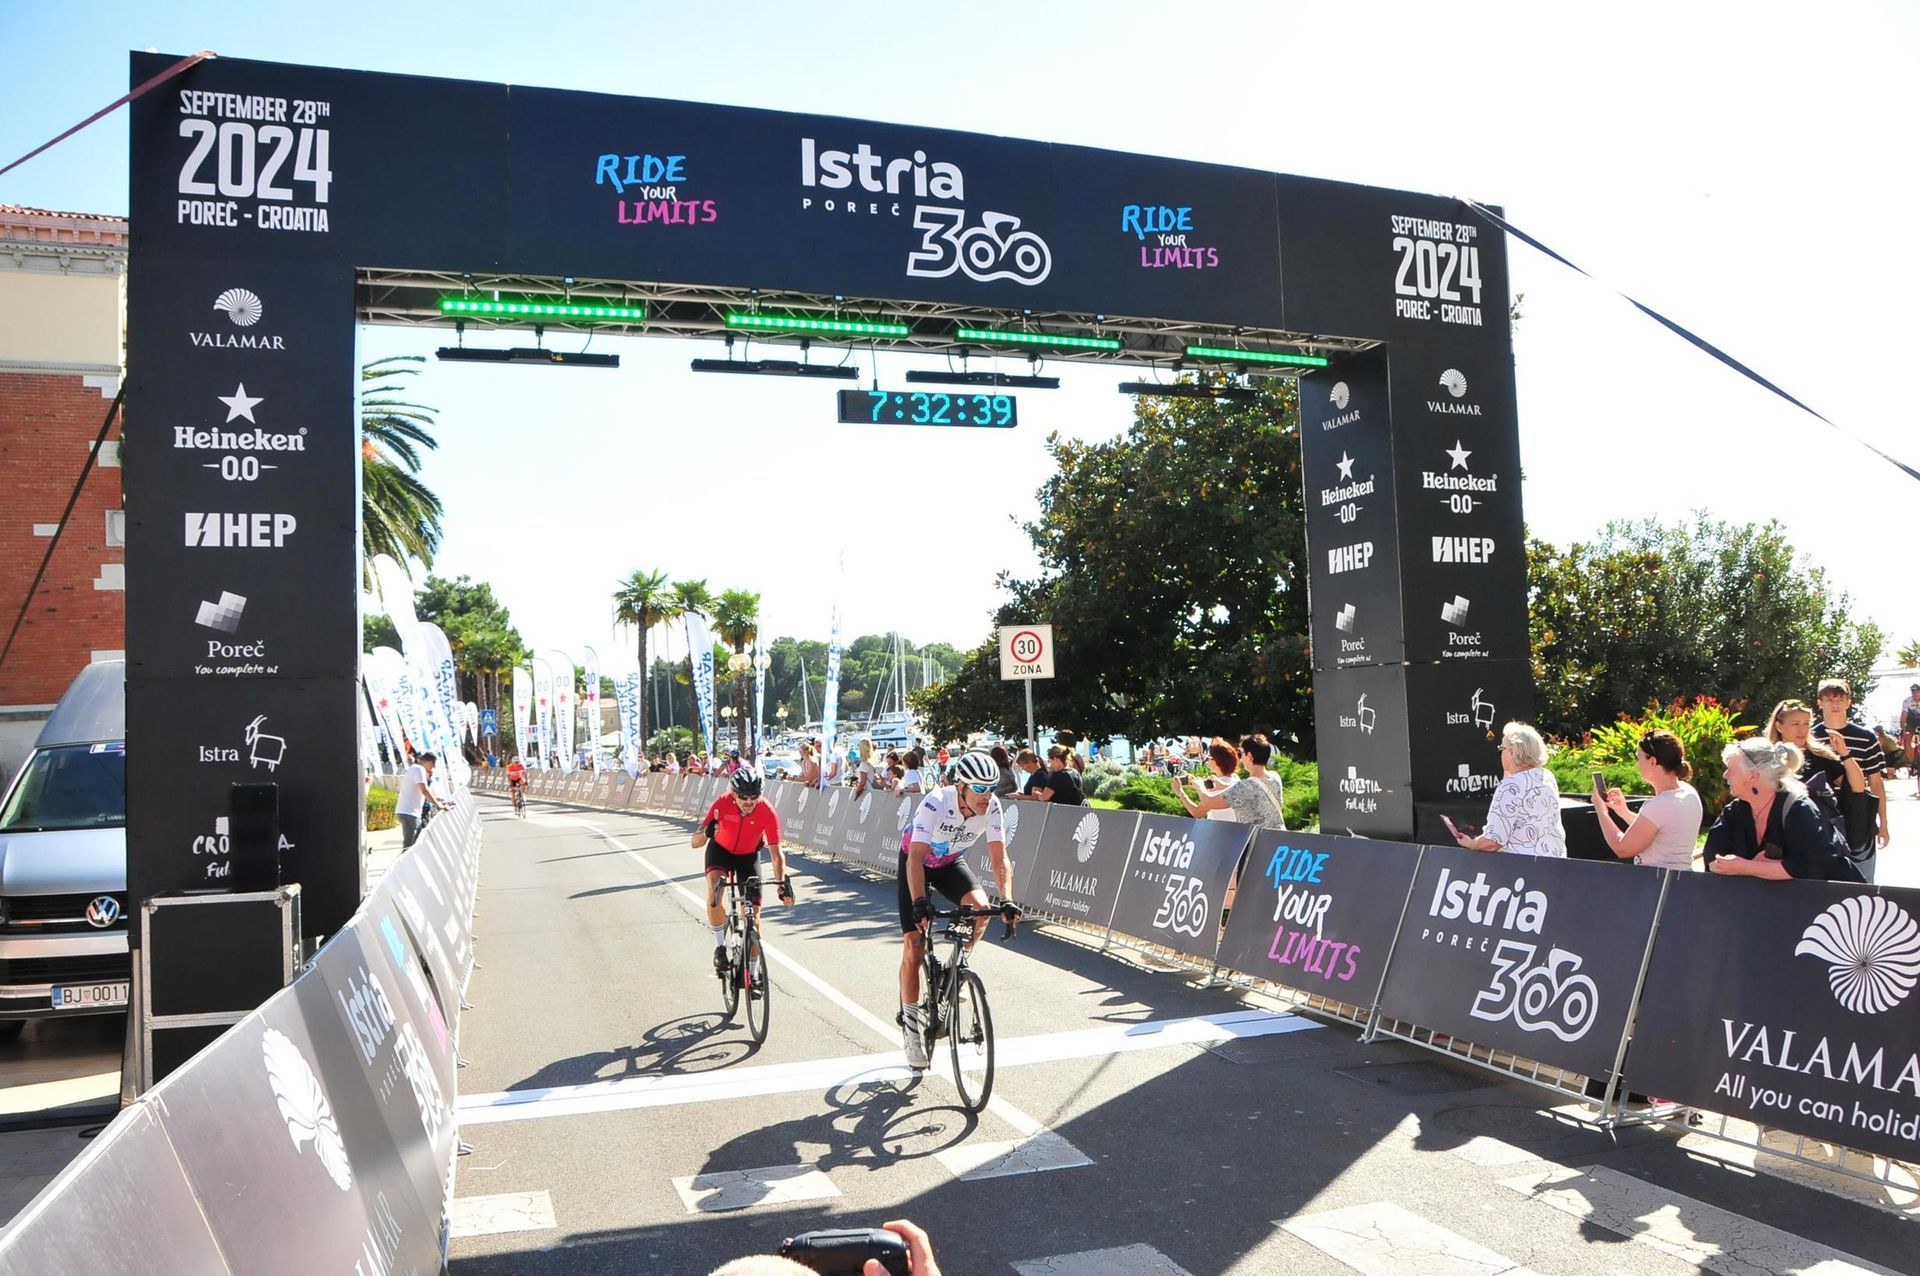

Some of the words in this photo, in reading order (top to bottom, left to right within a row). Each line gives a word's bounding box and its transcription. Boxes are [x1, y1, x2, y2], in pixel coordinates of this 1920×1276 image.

[180, 89, 287, 122] SEPTEMBER
[292, 100, 330, 124] 28TH
[178, 118, 333, 203] 2024
[595, 153, 688, 194] RIDE
[801, 137, 965, 201] Istria
[640, 185, 677, 202] YOUR
[178, 200, 238, 227] POREČ
[258, 204, 329, 233] CROATIA
[618, 199, 718, 225] LIMITS
[802, 198, 901, 217] POREČ
[1122, 204, 1194, 241] RIDE
[1391, 214, 1453, 241] SEPTEMBER
[906, 205, 1052, 286] 300
[1157, 234, 1188, 249] YOUR
[1141, 246, 1219, 270] LIMITS
[1393, 236, 1482, 304] 2024
[1396, 298, 1431, 322] POREČ
[1441, 302, 1483, 327] CROATIA
[189, 332, 286, 351] VALAMAR
[868, 390, 1012, 426] 7:32:39
[1322, 409, 1361, 431] VALAMAR
[1427, 400, 1482, 416] VALAMAR
[224, 513, 297, 547] HEP
[1342, 541, 1374, 572] HEP
[1454, 537, 1496, 563] HEP
[207, 640, 265, 658] Poreč
[1017, 639, 1036, 655] 30
[1341, 636, 1365, 652] Poreč
[1448, 632, 1481, 646] Poreč
[194, 664, 213, 675] You
[216, 663, 264, 677] complete
[266, 664, 279, 674] us
[1013, 664, 1042, 675] ZONA
[1339, 715, 1357, 728] Istra
[1446, 712, 1470, 724] Istra
[199, 746, 239, 761] Istra
[1339, 778, 1382, 794] CROATIA
[192, 833, 295, 855] CROA
[1139, 828, 1195, 871] Istria
[206, 860, 231, 878] Ful
[981, 855, 1016, 877] VALR
[1265, 844, 1332, 889] RIDE
[1050, 869, 1098, 897] VALAMAR
[1071, 897, 1091, 917] holiday
[1272, 884, 1332, 941] YOUR
[1428, 867, 1549, 937] Istria
[1267, 925, 1361, 982] LIMITS
[1421, 928, 1488, 953] POREČ
[63, 989, 82, 1003] BJ
[1469, 938, 1599, 1043] 300
[338, 965, 396, 1067] Istria
[1721, 1017, 1920, 1099] VALAMA
[1714, 1072, 1746, 1099] All
[1748, 1085, 1792, 1110] you
[1798, 1098, 1844, 1124] can
[1851, 1101, 1920, 1141] holid
